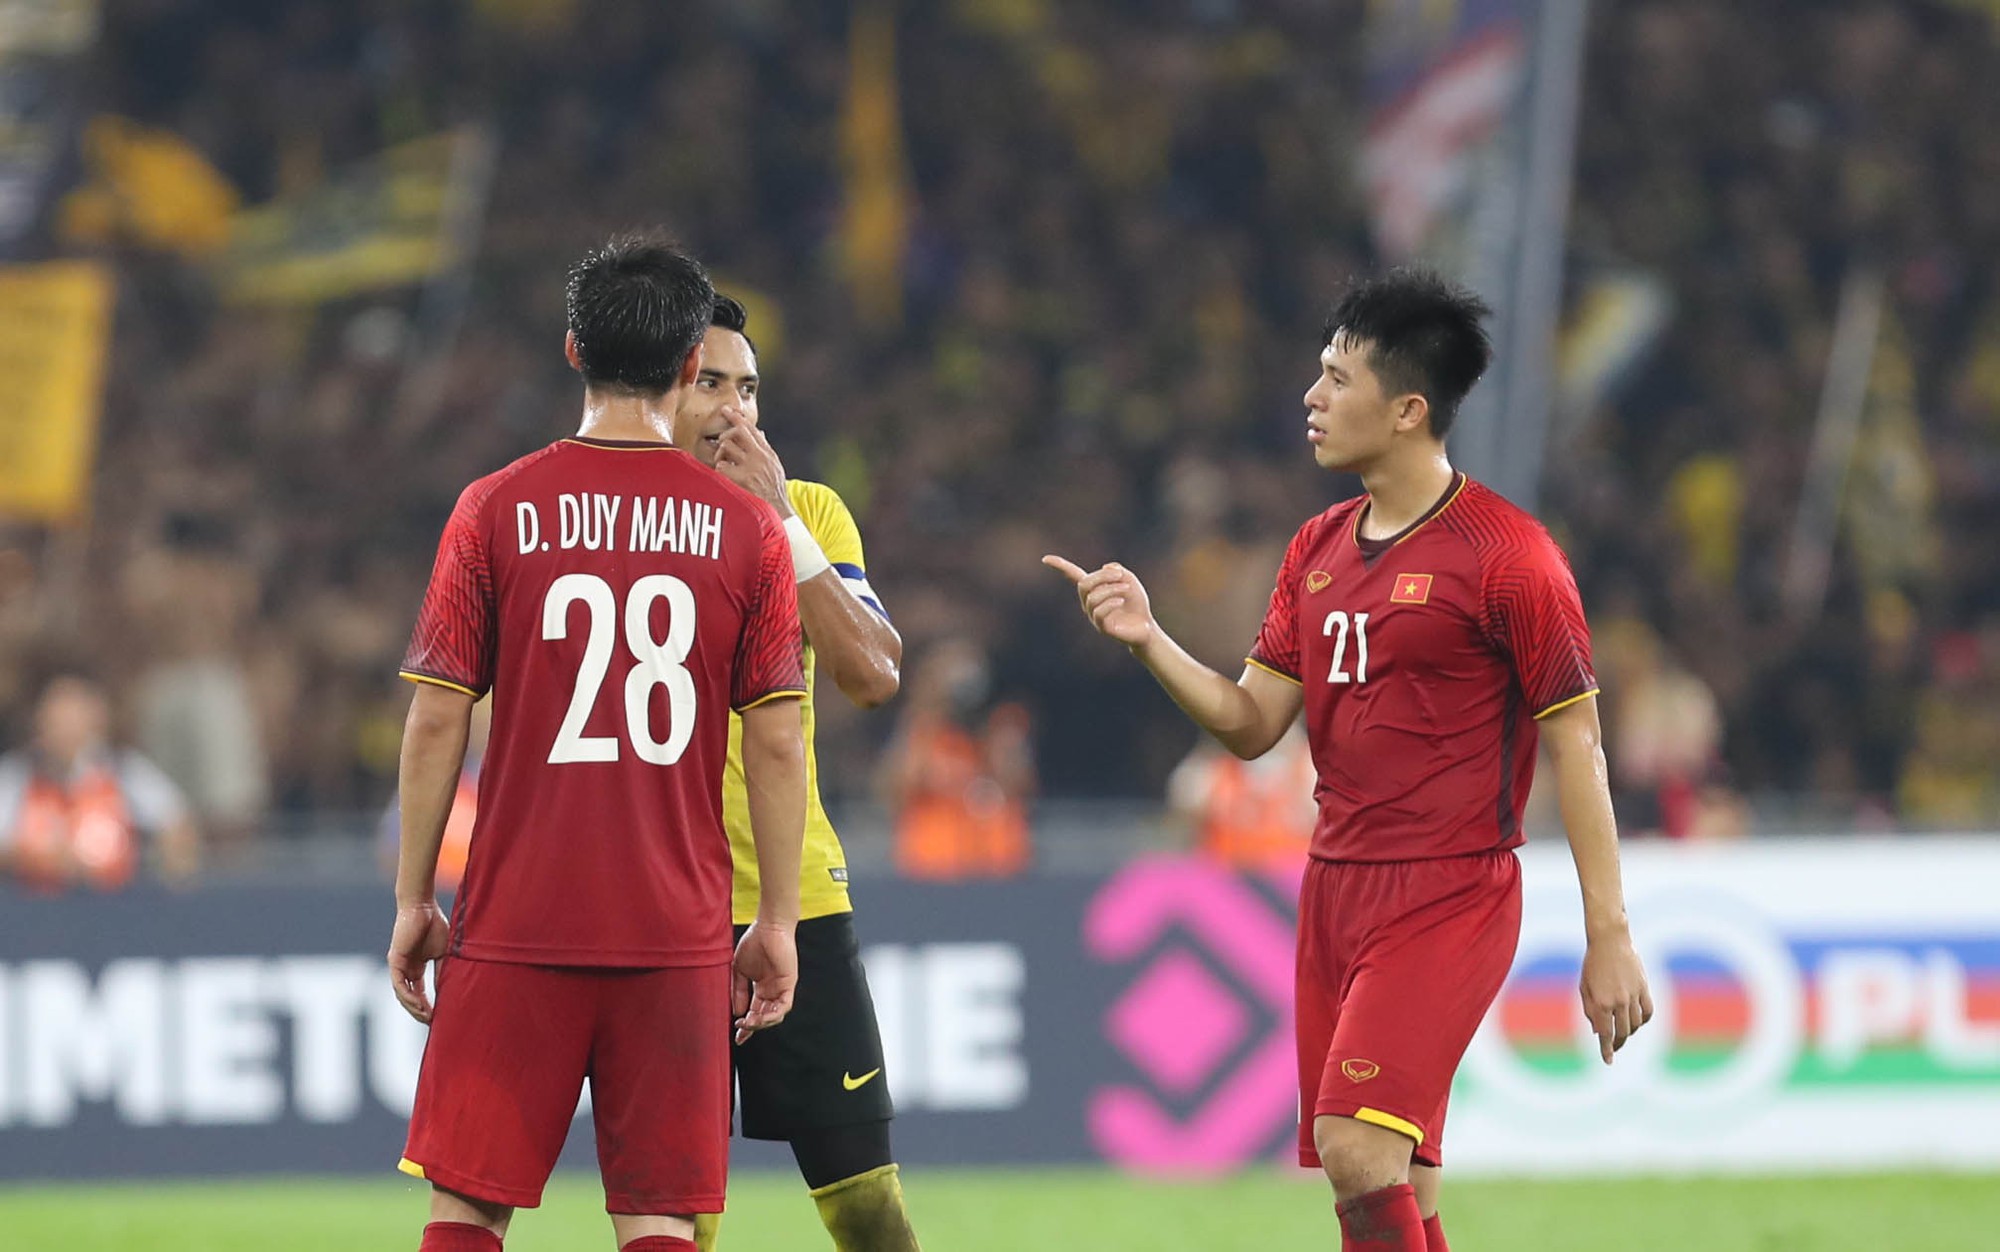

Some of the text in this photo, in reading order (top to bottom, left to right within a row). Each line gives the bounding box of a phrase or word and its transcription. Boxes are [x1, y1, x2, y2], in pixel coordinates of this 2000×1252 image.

[516, 492, 723, 560] D. DUY MANH
[542, 573, 697, 766] 28
[1323, 610, 1369, 683] 21
